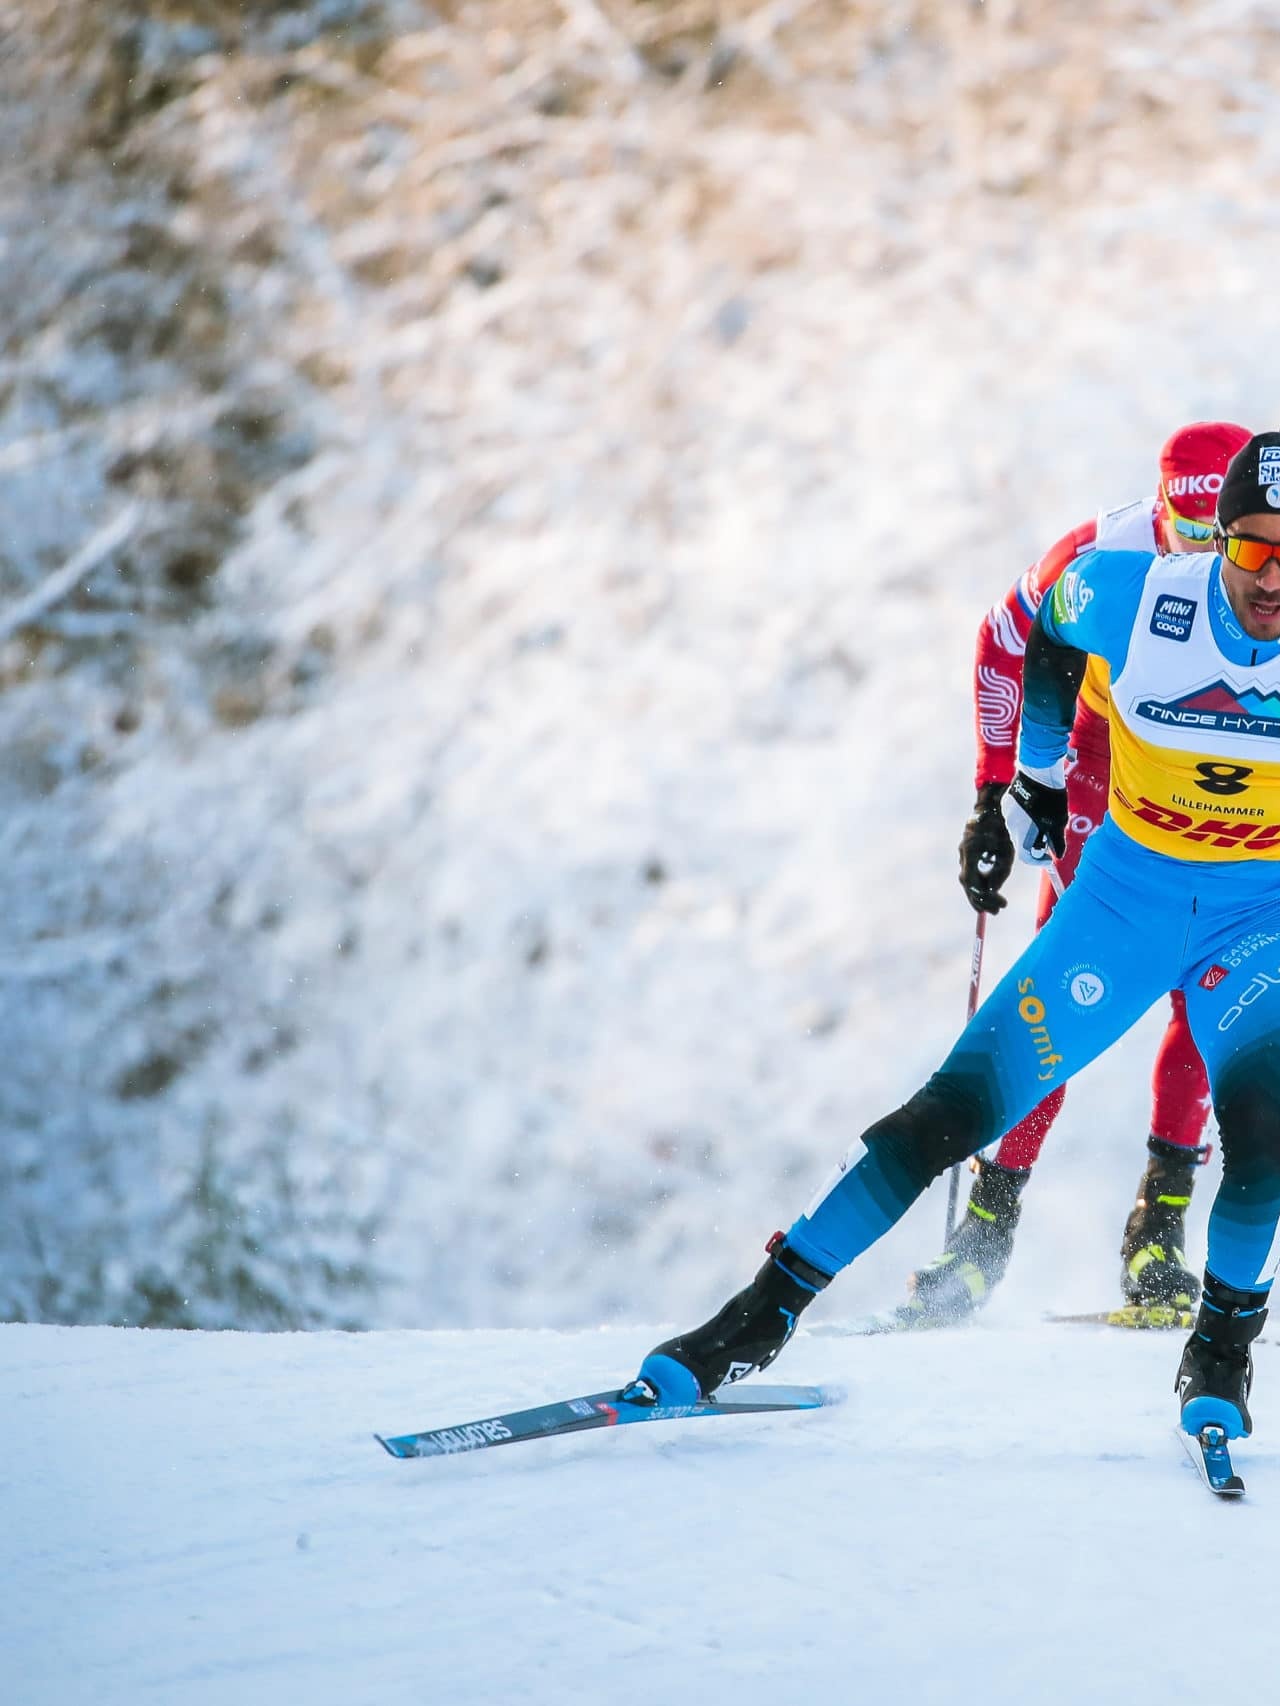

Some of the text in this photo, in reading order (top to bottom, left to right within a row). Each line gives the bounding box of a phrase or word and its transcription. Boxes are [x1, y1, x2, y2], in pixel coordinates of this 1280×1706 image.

[1155, 611, 1192, 626] WORLD CUP
[1156, 621, 1185, 637] coop
[1147, 704, 1218, 726] TINDE
[1193, 761, 1255, 796] 8
[1171, 793, 1266, 817] LILLEHAMMER
[1017, 976, 1064, 1081] somfy
